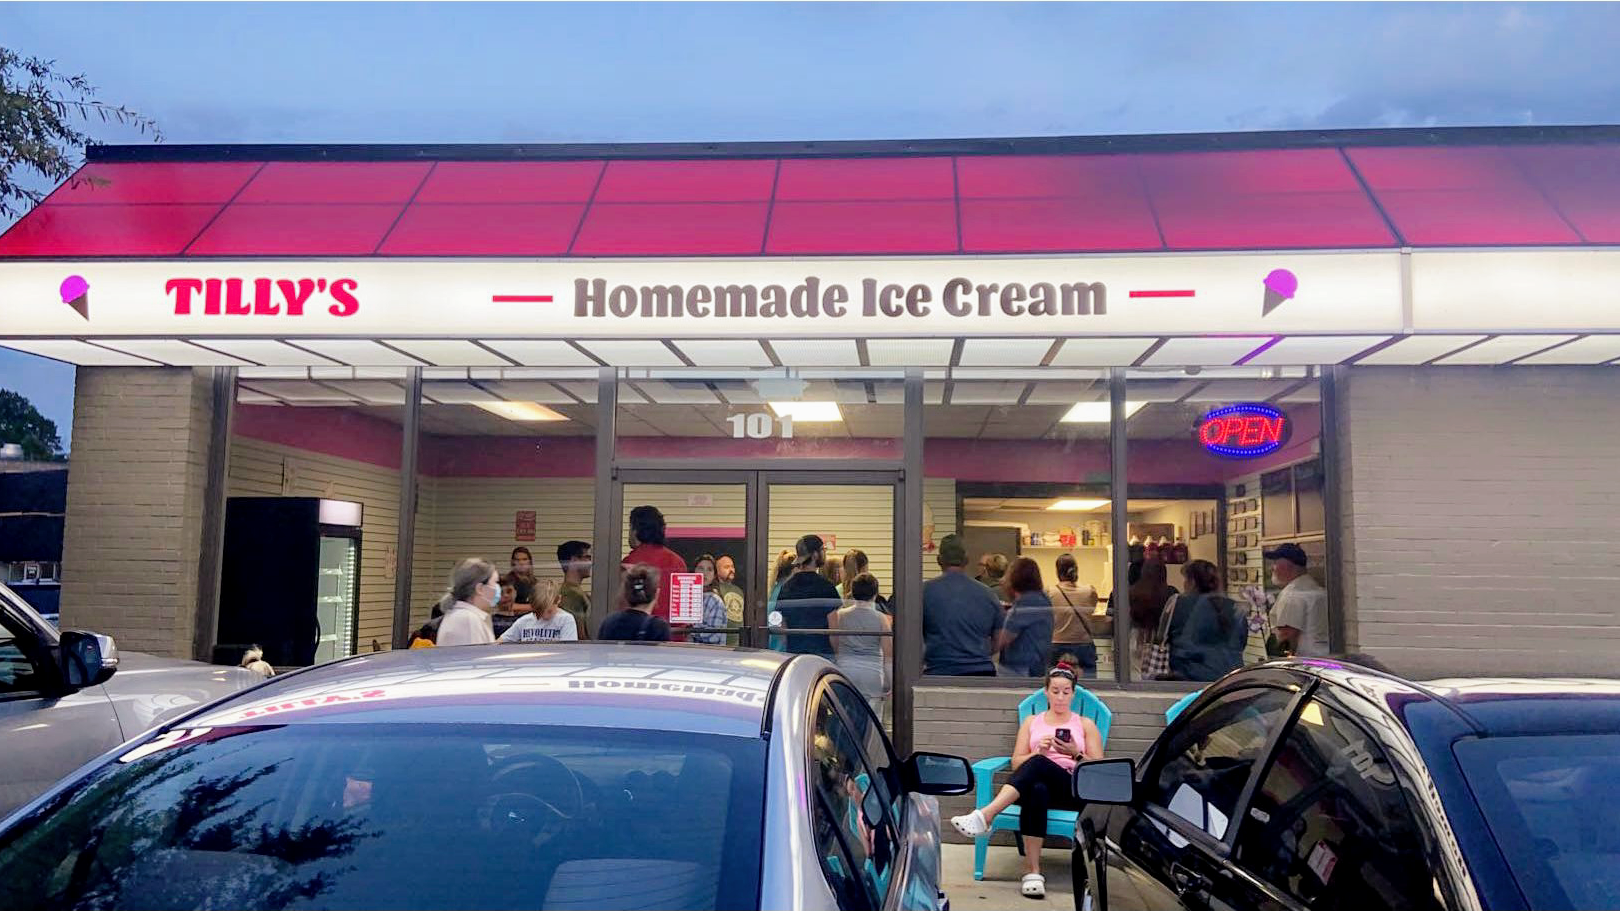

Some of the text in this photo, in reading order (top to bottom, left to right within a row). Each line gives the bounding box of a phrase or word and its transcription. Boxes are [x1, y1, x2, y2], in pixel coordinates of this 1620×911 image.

[165, 277, 360, 318] TILLY'S
[573, 276, 1107, 318] Homemade Ice Cream
[726, 412, 794, 439] 101
[1199, 416, 1286, 446] OPEN
